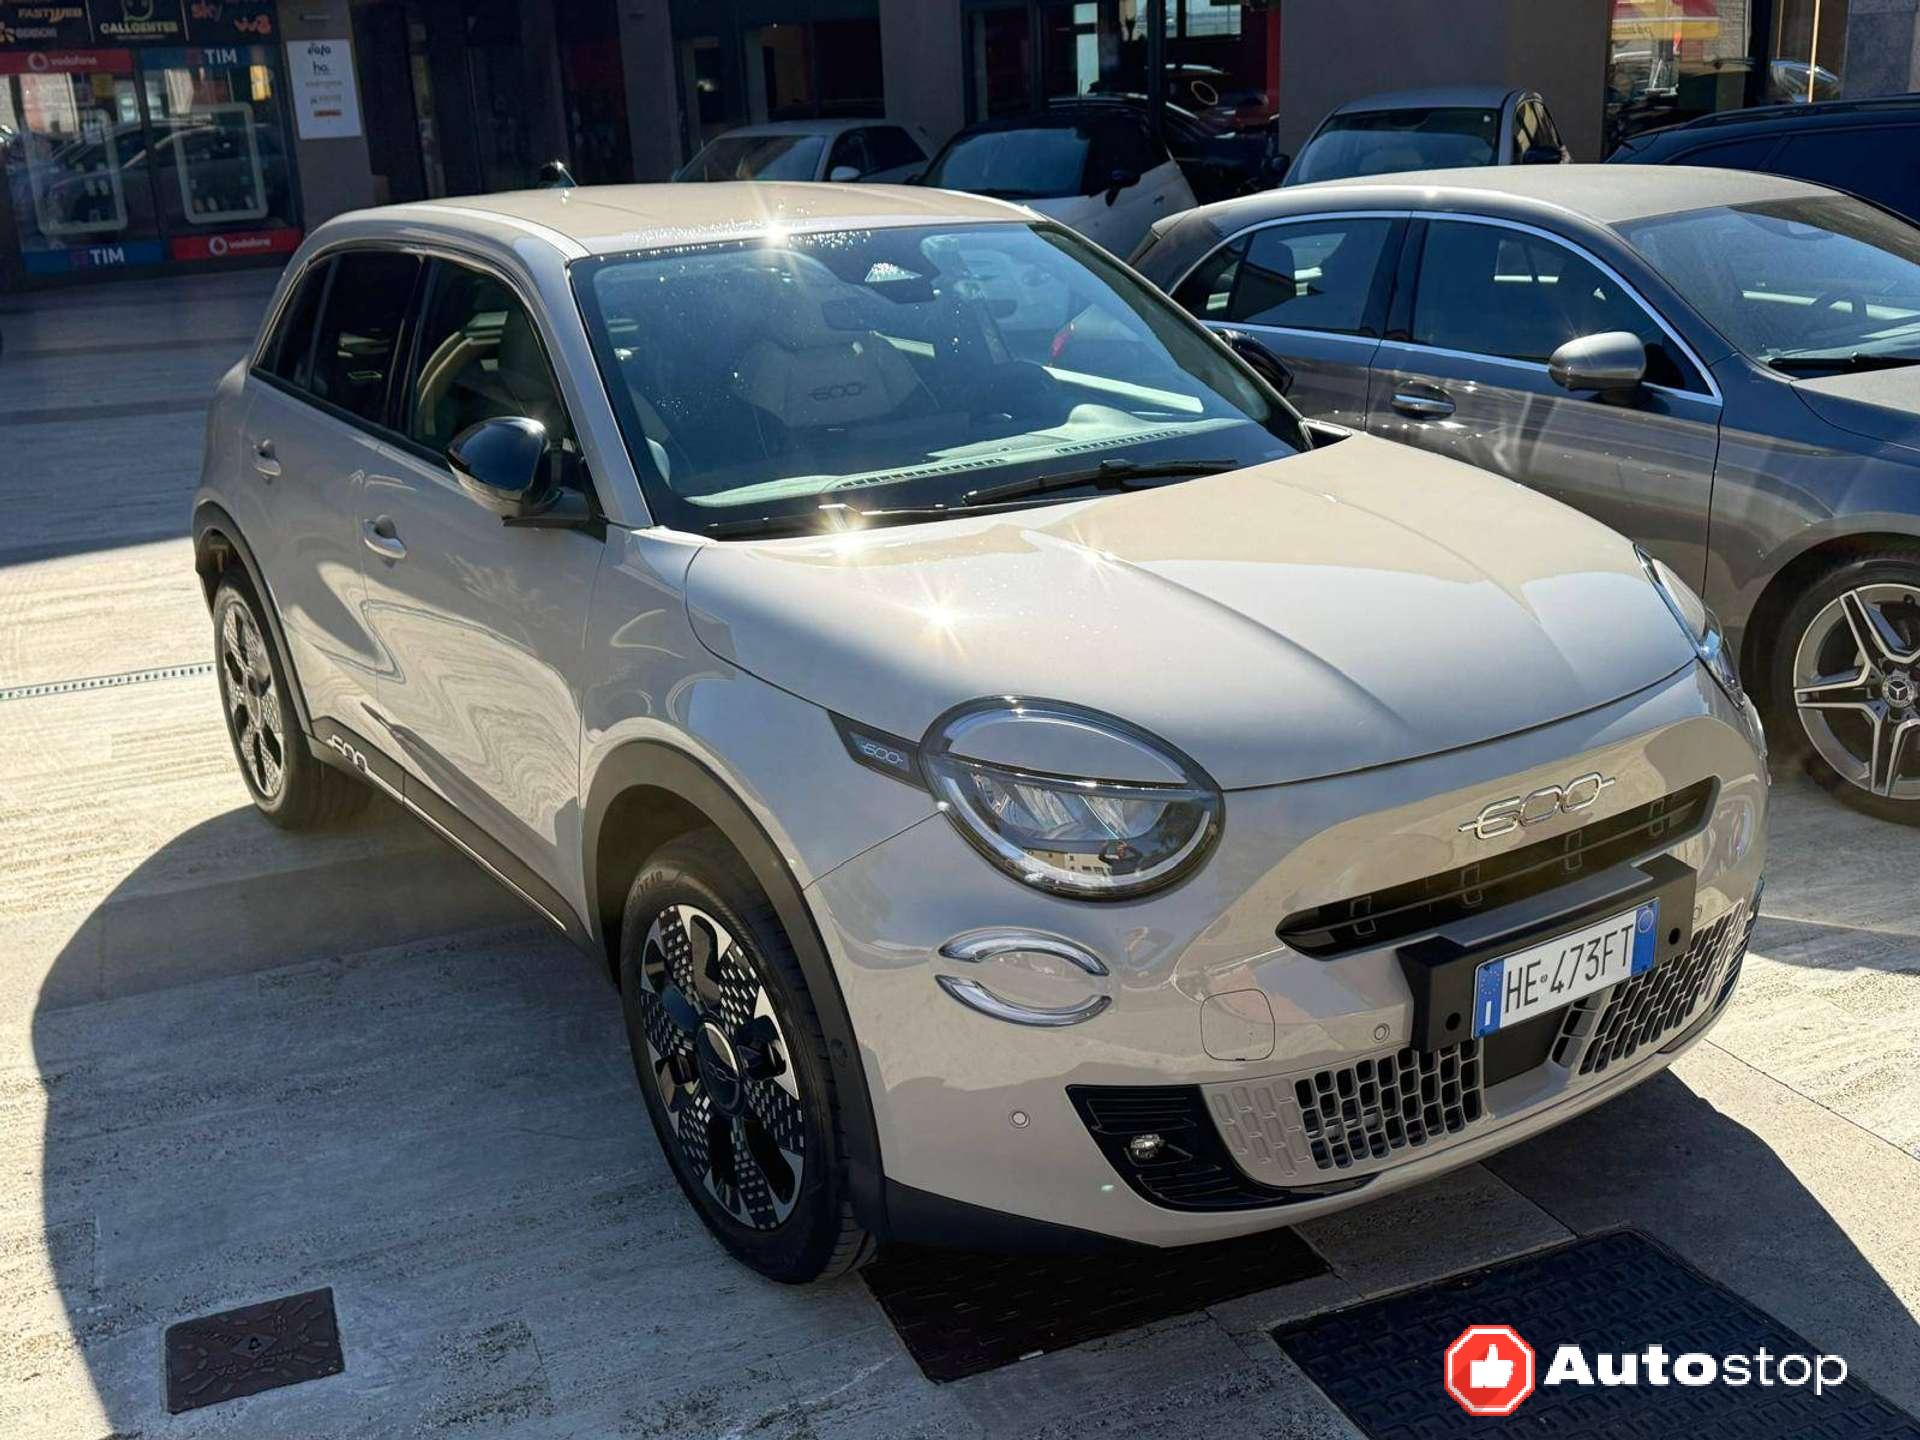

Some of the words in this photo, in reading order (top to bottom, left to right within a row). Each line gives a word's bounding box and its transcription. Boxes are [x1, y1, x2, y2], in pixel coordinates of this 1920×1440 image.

[203, 48, 238, 64] TIM
[90, 247, 124, 265] TIM
[861, 743, 903, 764] 600
[1458, 771, 1616, 840] 600
